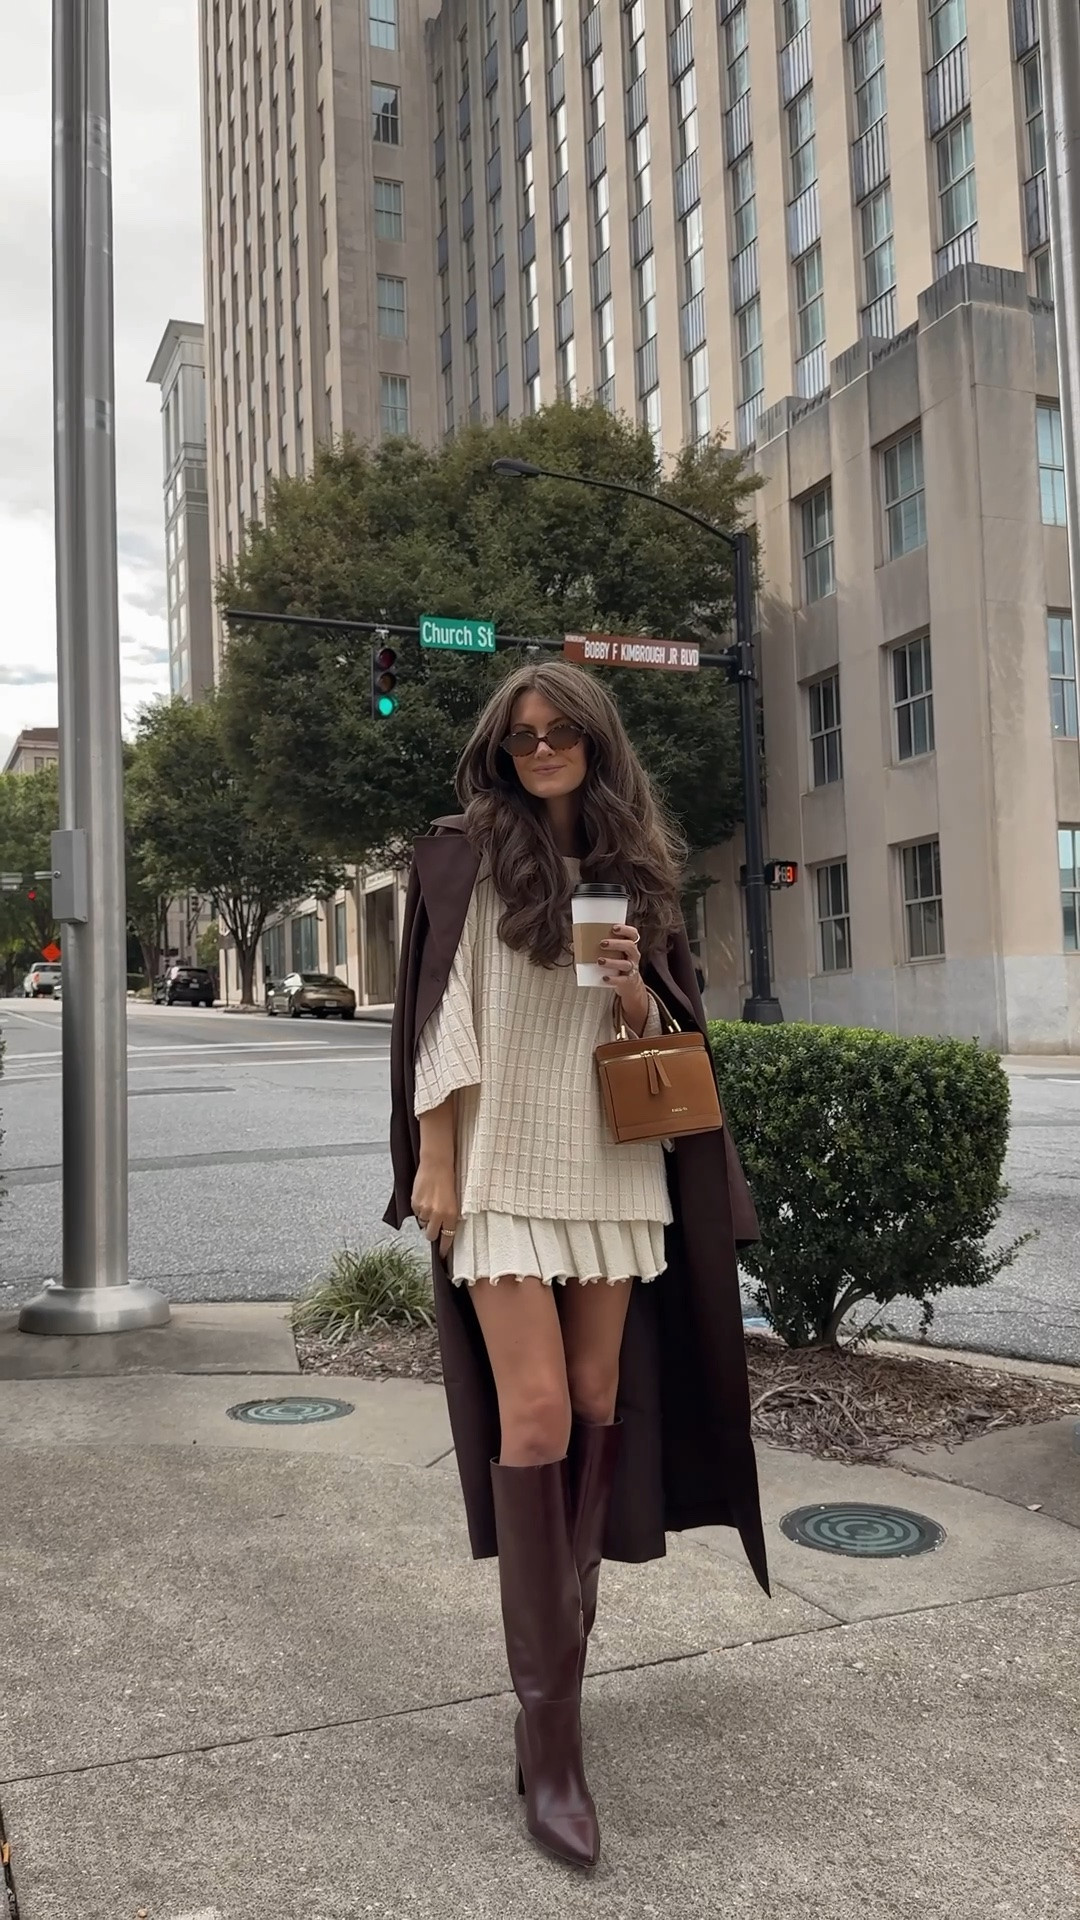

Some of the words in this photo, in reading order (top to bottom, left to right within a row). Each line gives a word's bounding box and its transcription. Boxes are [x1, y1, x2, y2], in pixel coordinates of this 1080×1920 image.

[423, 621, 473, 646] Church
[477, 626, 494, 648] St
[585, 641, 610, 660] BOBBY
[612, 643, 618, 660] F
[621, 643, 665, 664] KIMBROUGH
[667, 647, 678, 665] JR
[680, 648, 699, 667] BLVD
